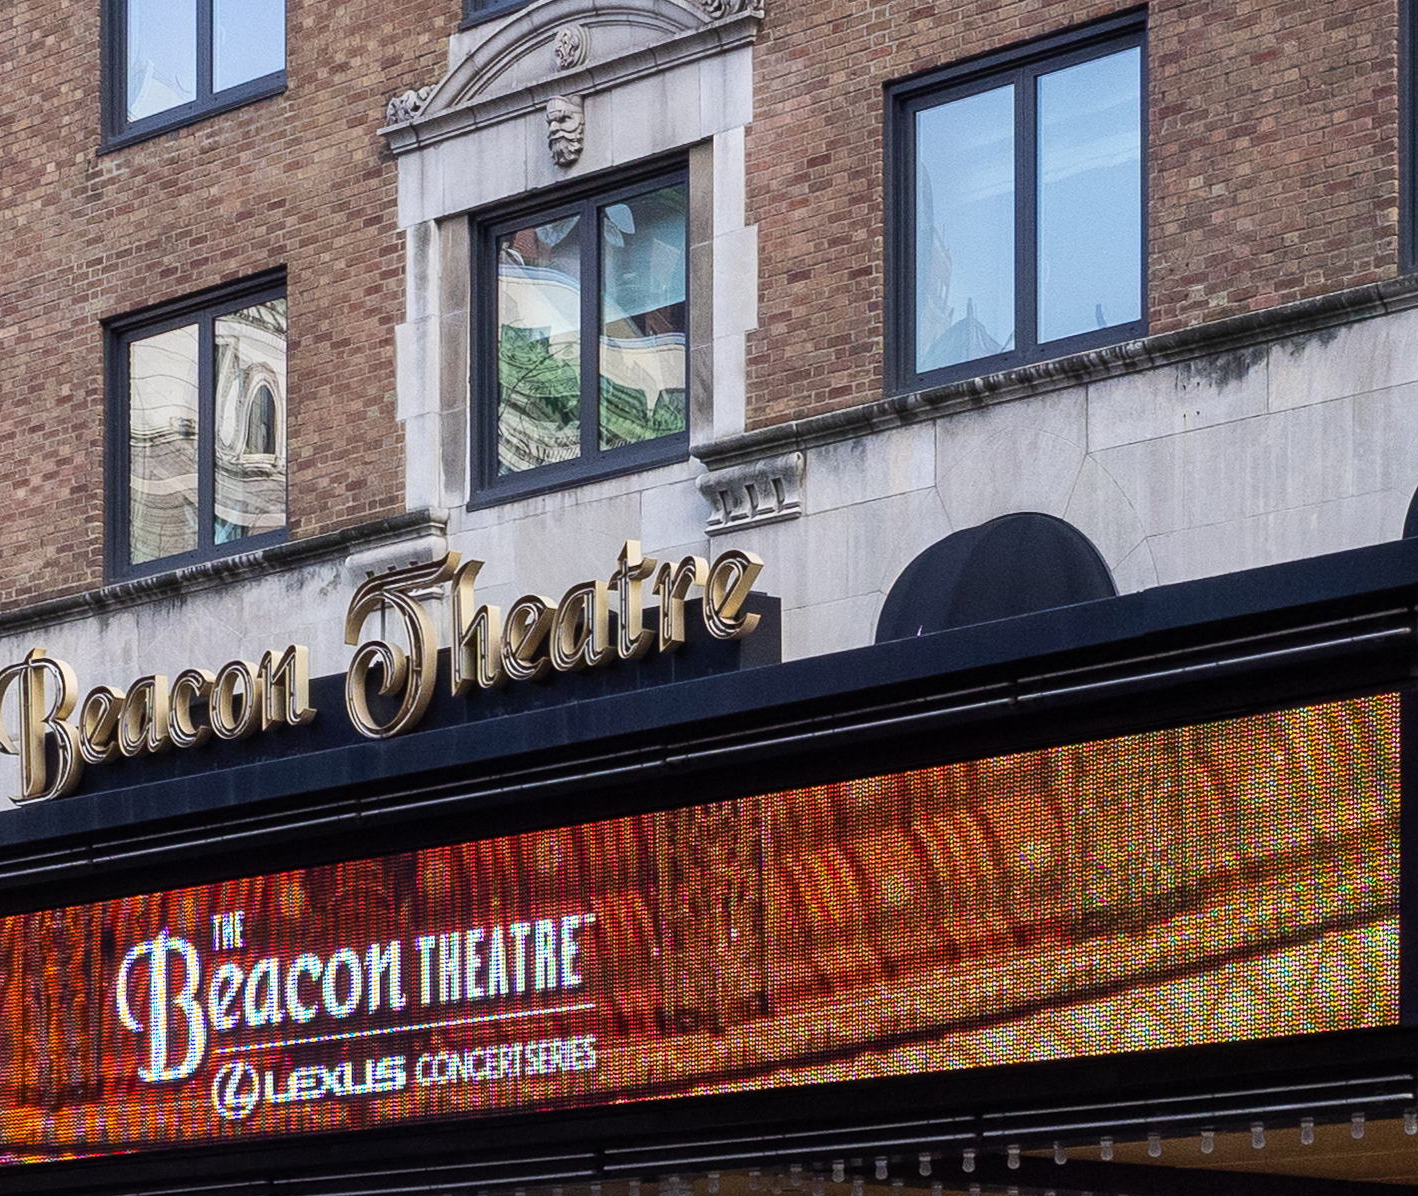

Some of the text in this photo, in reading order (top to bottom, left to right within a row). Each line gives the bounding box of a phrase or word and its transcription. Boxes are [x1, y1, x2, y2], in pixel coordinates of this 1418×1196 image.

[345, 540, 764, 739] Theatre
[212, 911, 245, 951] THE
[416, 915, 585, 1006] THEATRE
[264, 1055, 407, 1104] LEXUS
